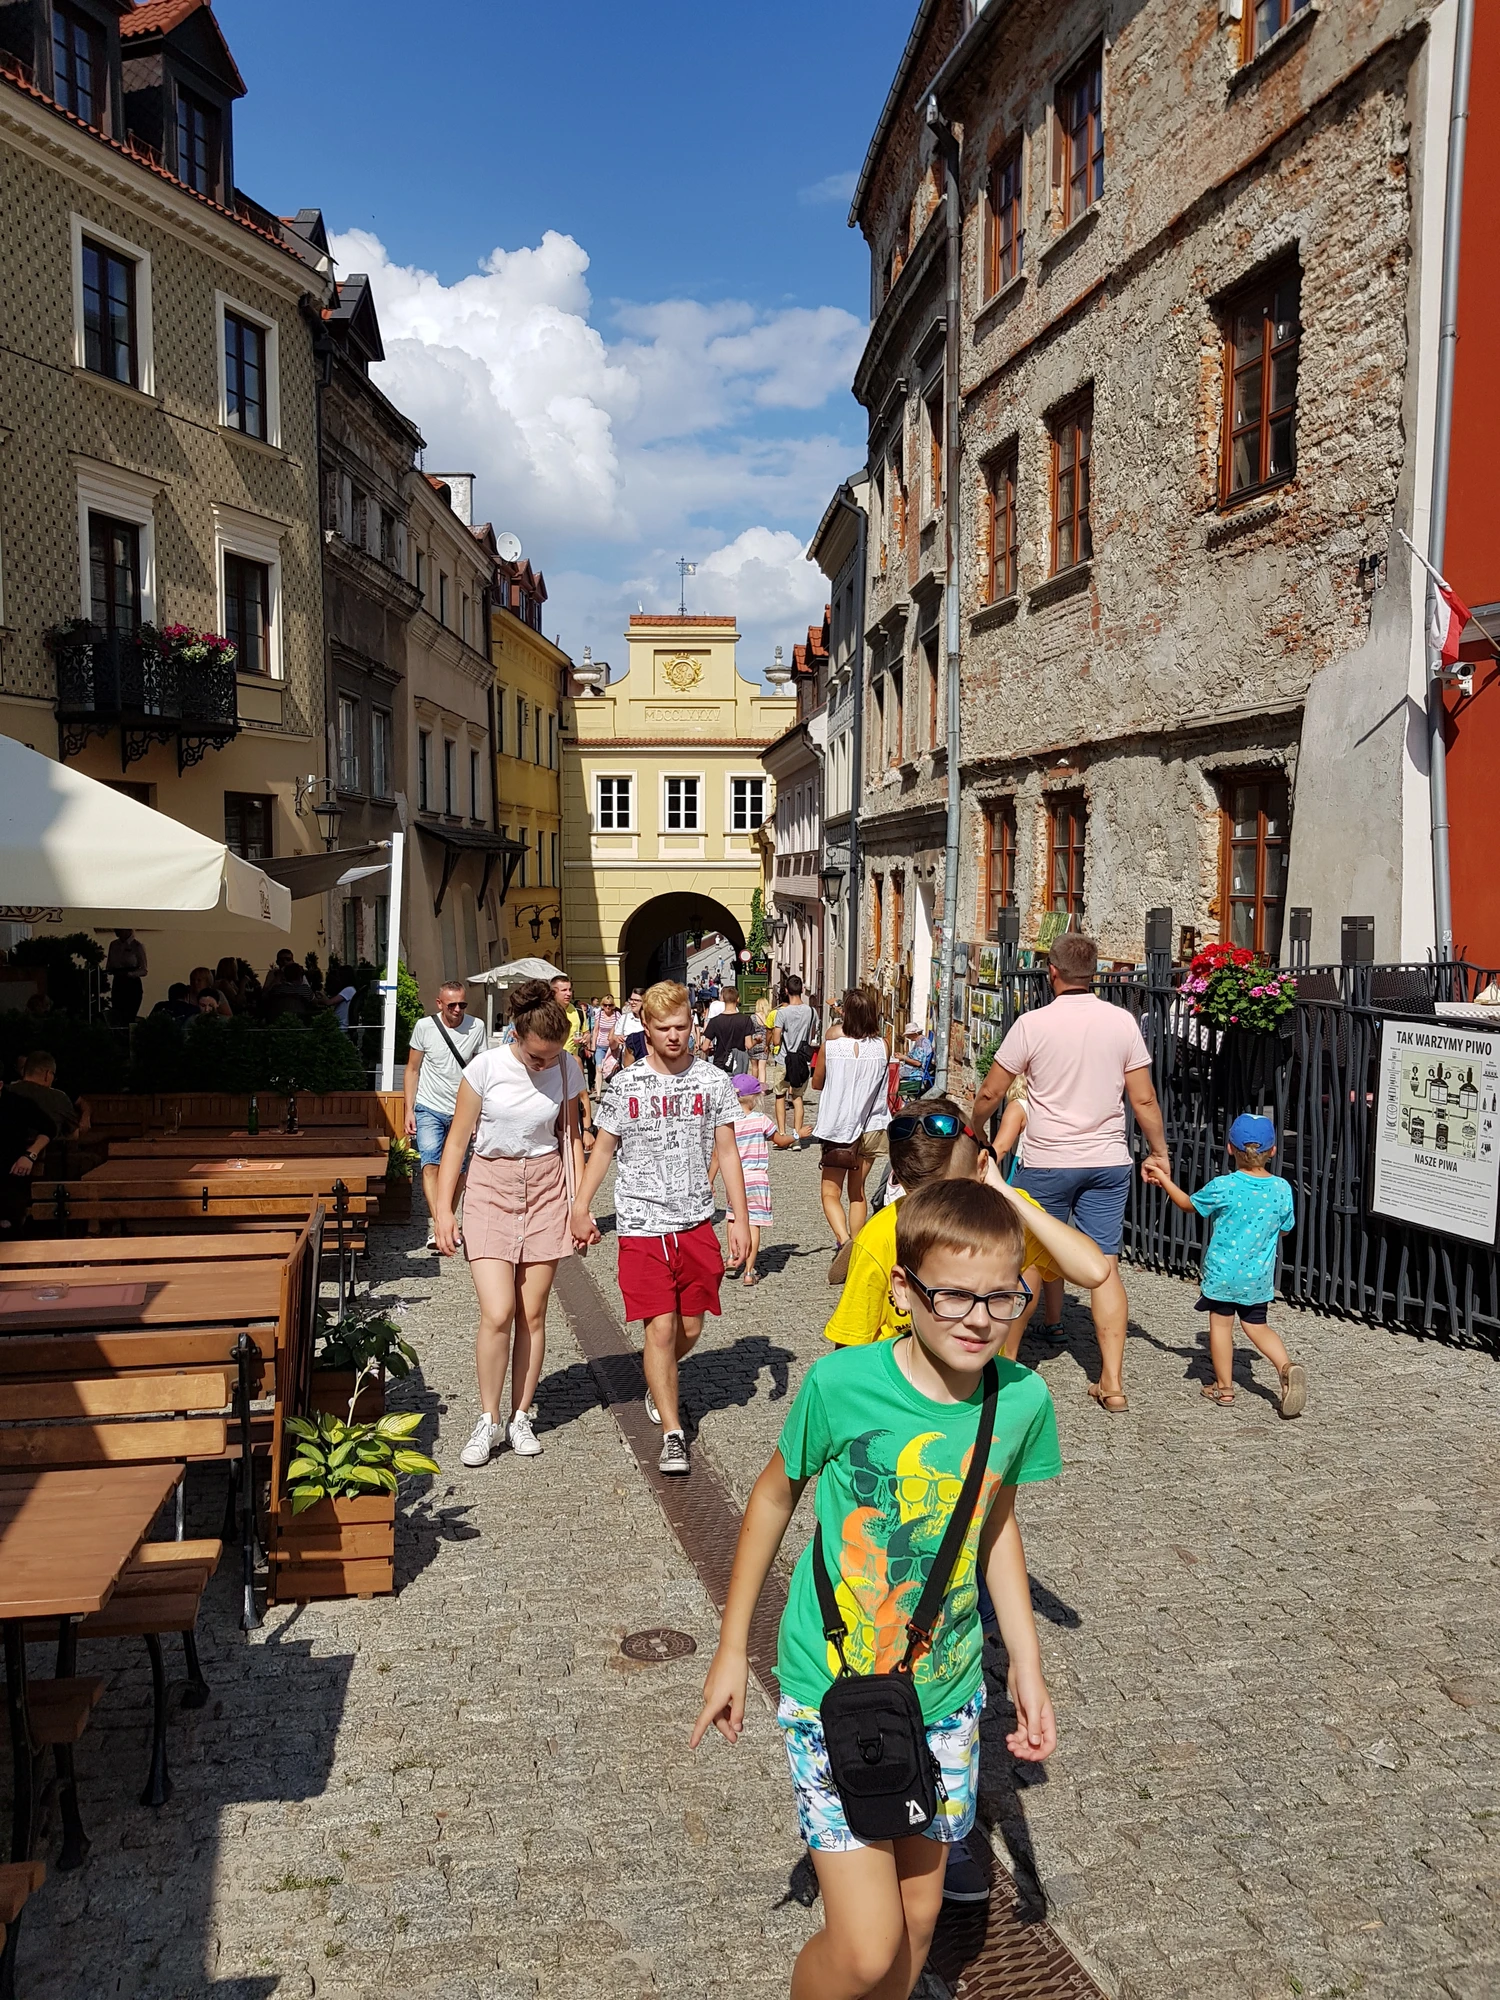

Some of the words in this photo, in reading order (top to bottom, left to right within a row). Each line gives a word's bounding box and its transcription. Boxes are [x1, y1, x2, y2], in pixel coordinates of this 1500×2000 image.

[1396, 1030, 1414, 1046] TAK
[1415, 1033, 1464, 1052] WARZYMY
[1465, 1039, 1492, 1056] PIWO
[1414, 1153, 1437, 1168] NASZE
[1438, 1158, 1458, 1173] PIWA
